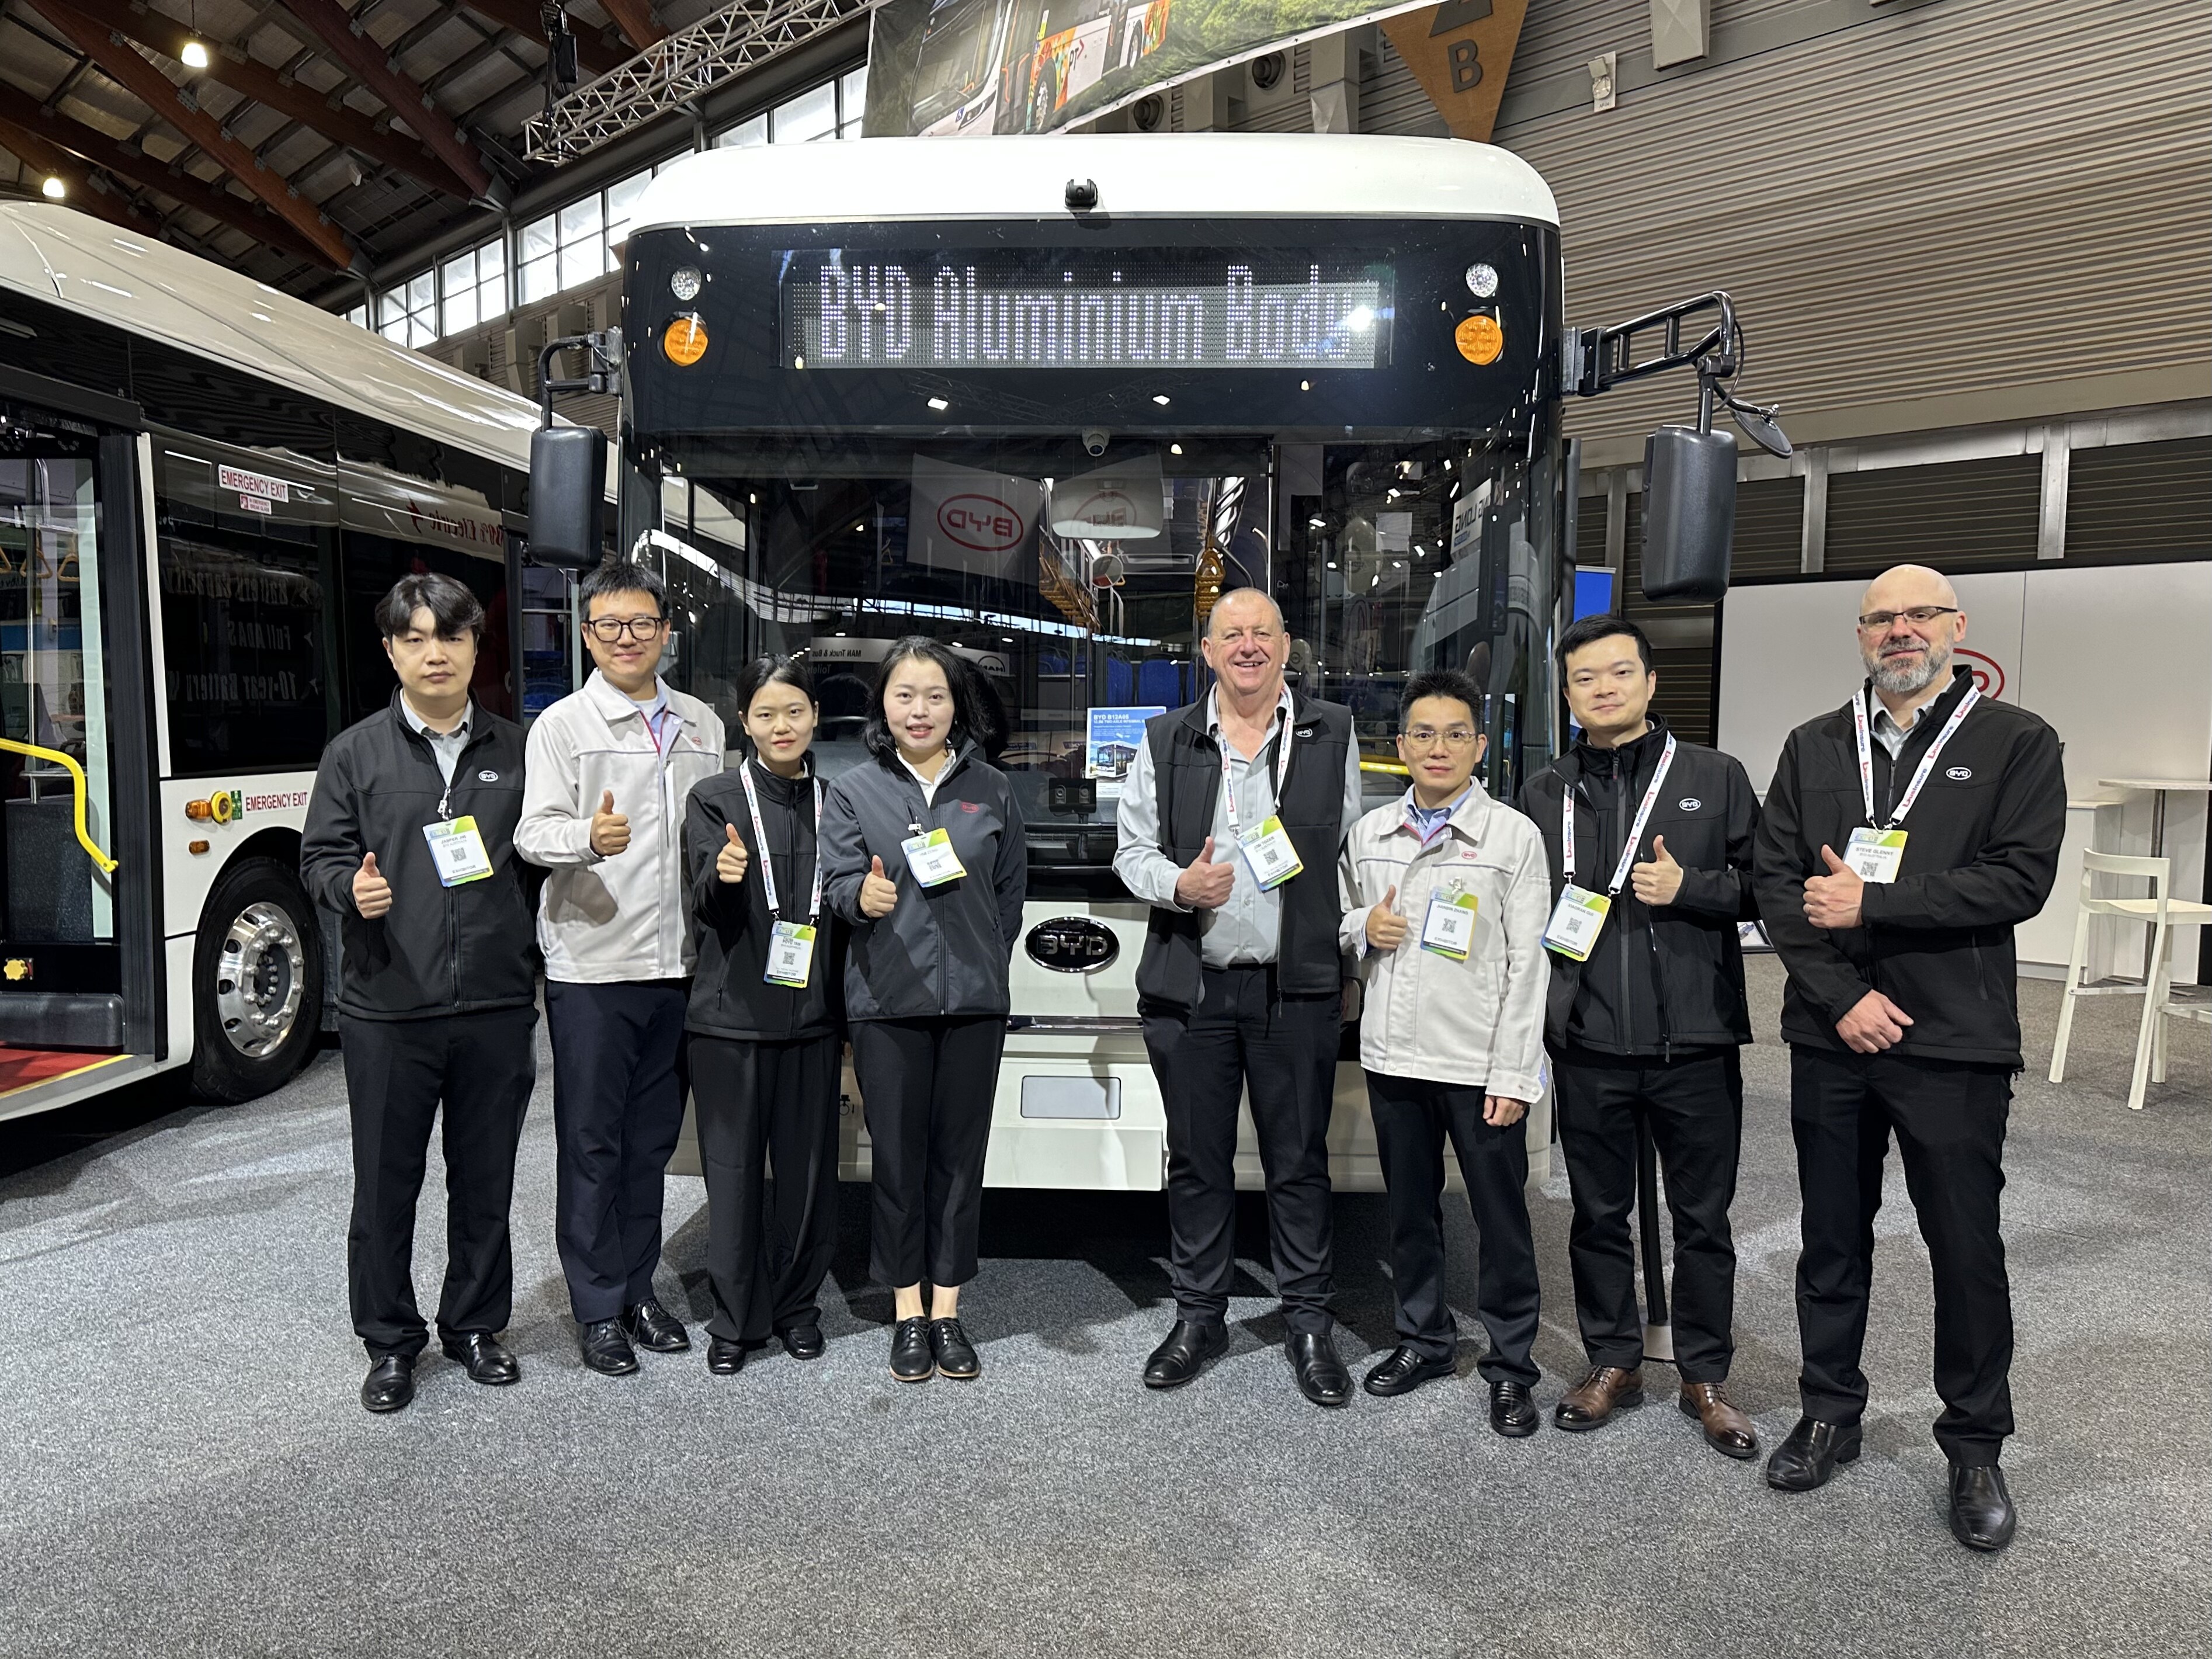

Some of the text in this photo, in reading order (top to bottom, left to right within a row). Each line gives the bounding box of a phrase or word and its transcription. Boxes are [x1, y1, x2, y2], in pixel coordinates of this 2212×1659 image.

[1447, 39, 1484, 93] B
[821, 264, 1350, 359] BYD Aluminium Body
[221, 470, 286, 499] EMERGENCY EXIT
[246, 792, 307, 811] EMERGENCY EXIT
[1037, 935, 1108, 956] BYD
